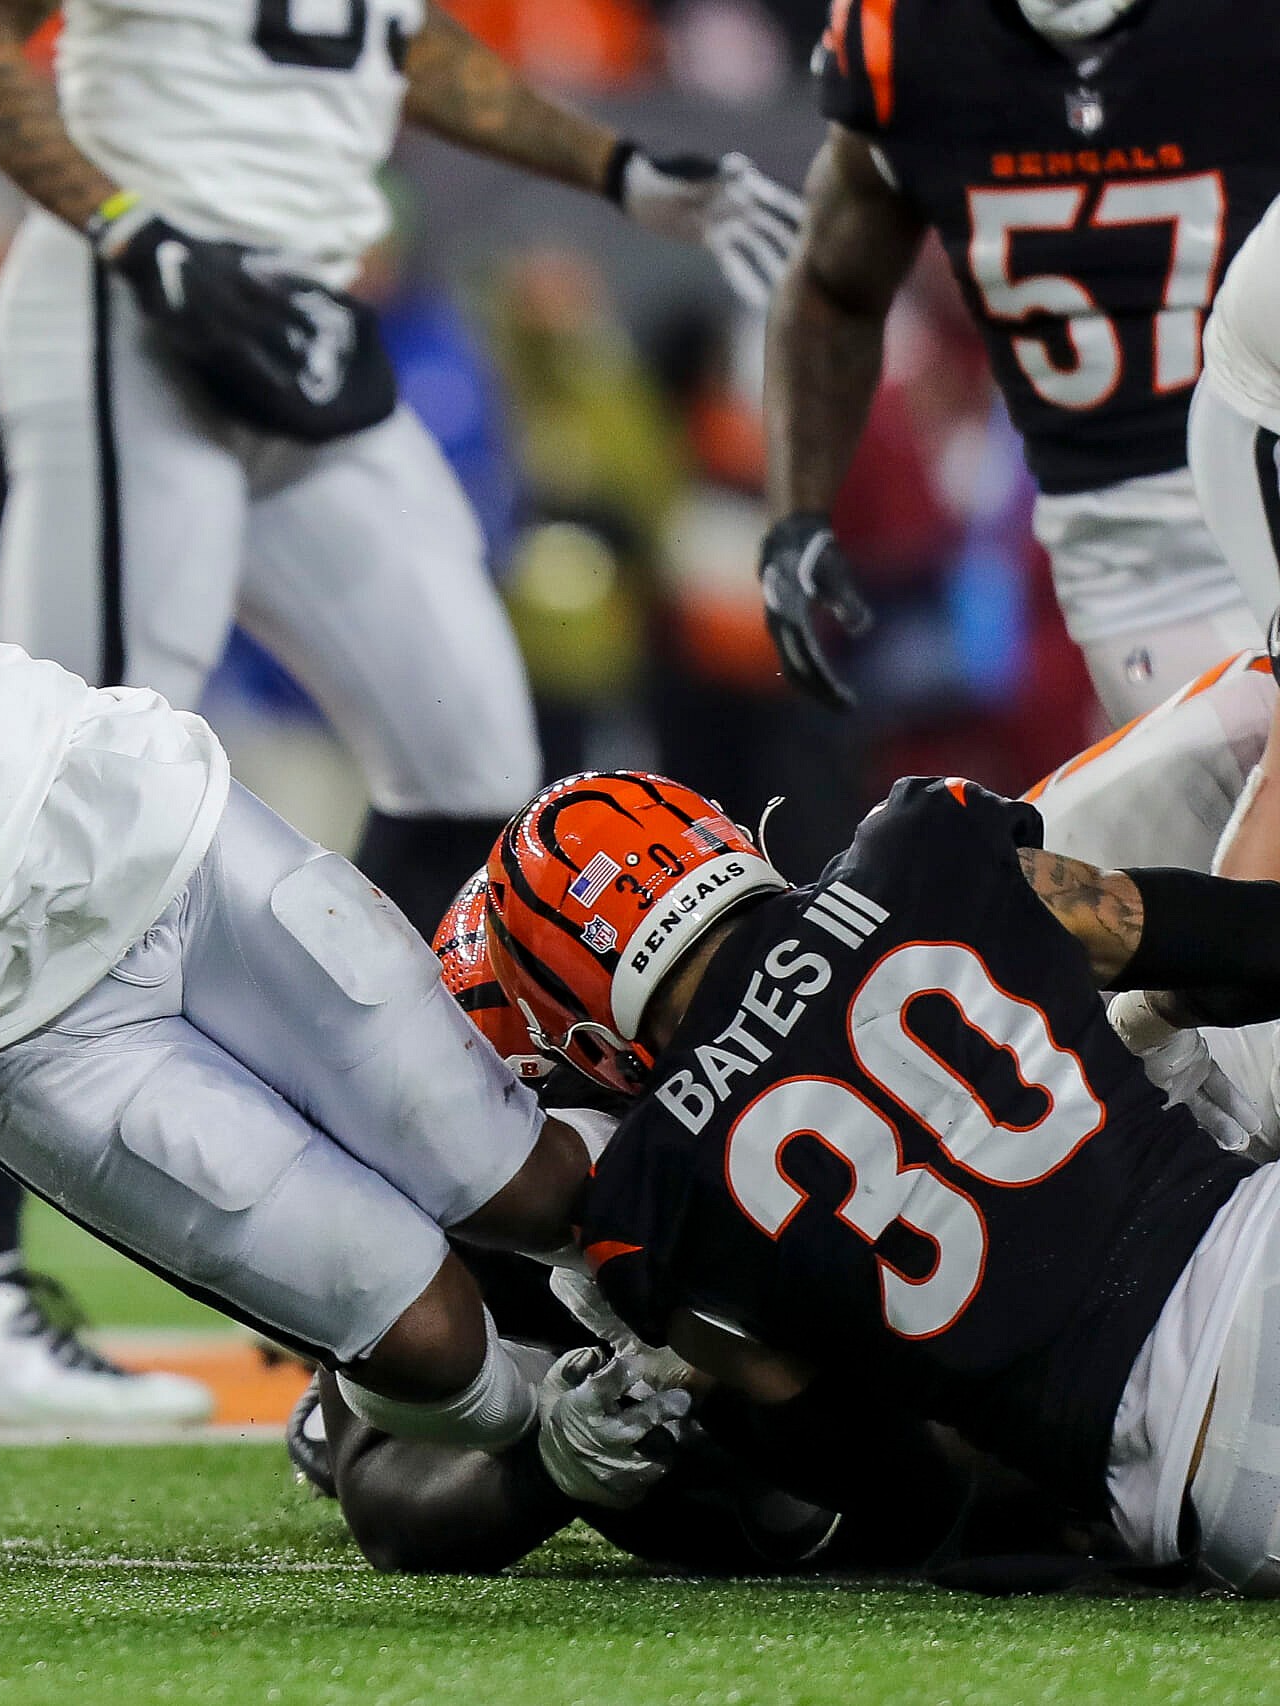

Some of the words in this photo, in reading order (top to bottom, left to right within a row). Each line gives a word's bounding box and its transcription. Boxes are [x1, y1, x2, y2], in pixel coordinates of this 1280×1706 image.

[991, 145, 1182, 175] BENGALS
[967, 170, 1225, 410] 57
[615, 843, 686, 909] 30
[631, 862, 745, 974] BENGALS
[655, 938, 832, 1136] BATES
[803, 880, 890, 951] III
[726, 941, 1106, 1338] 30
